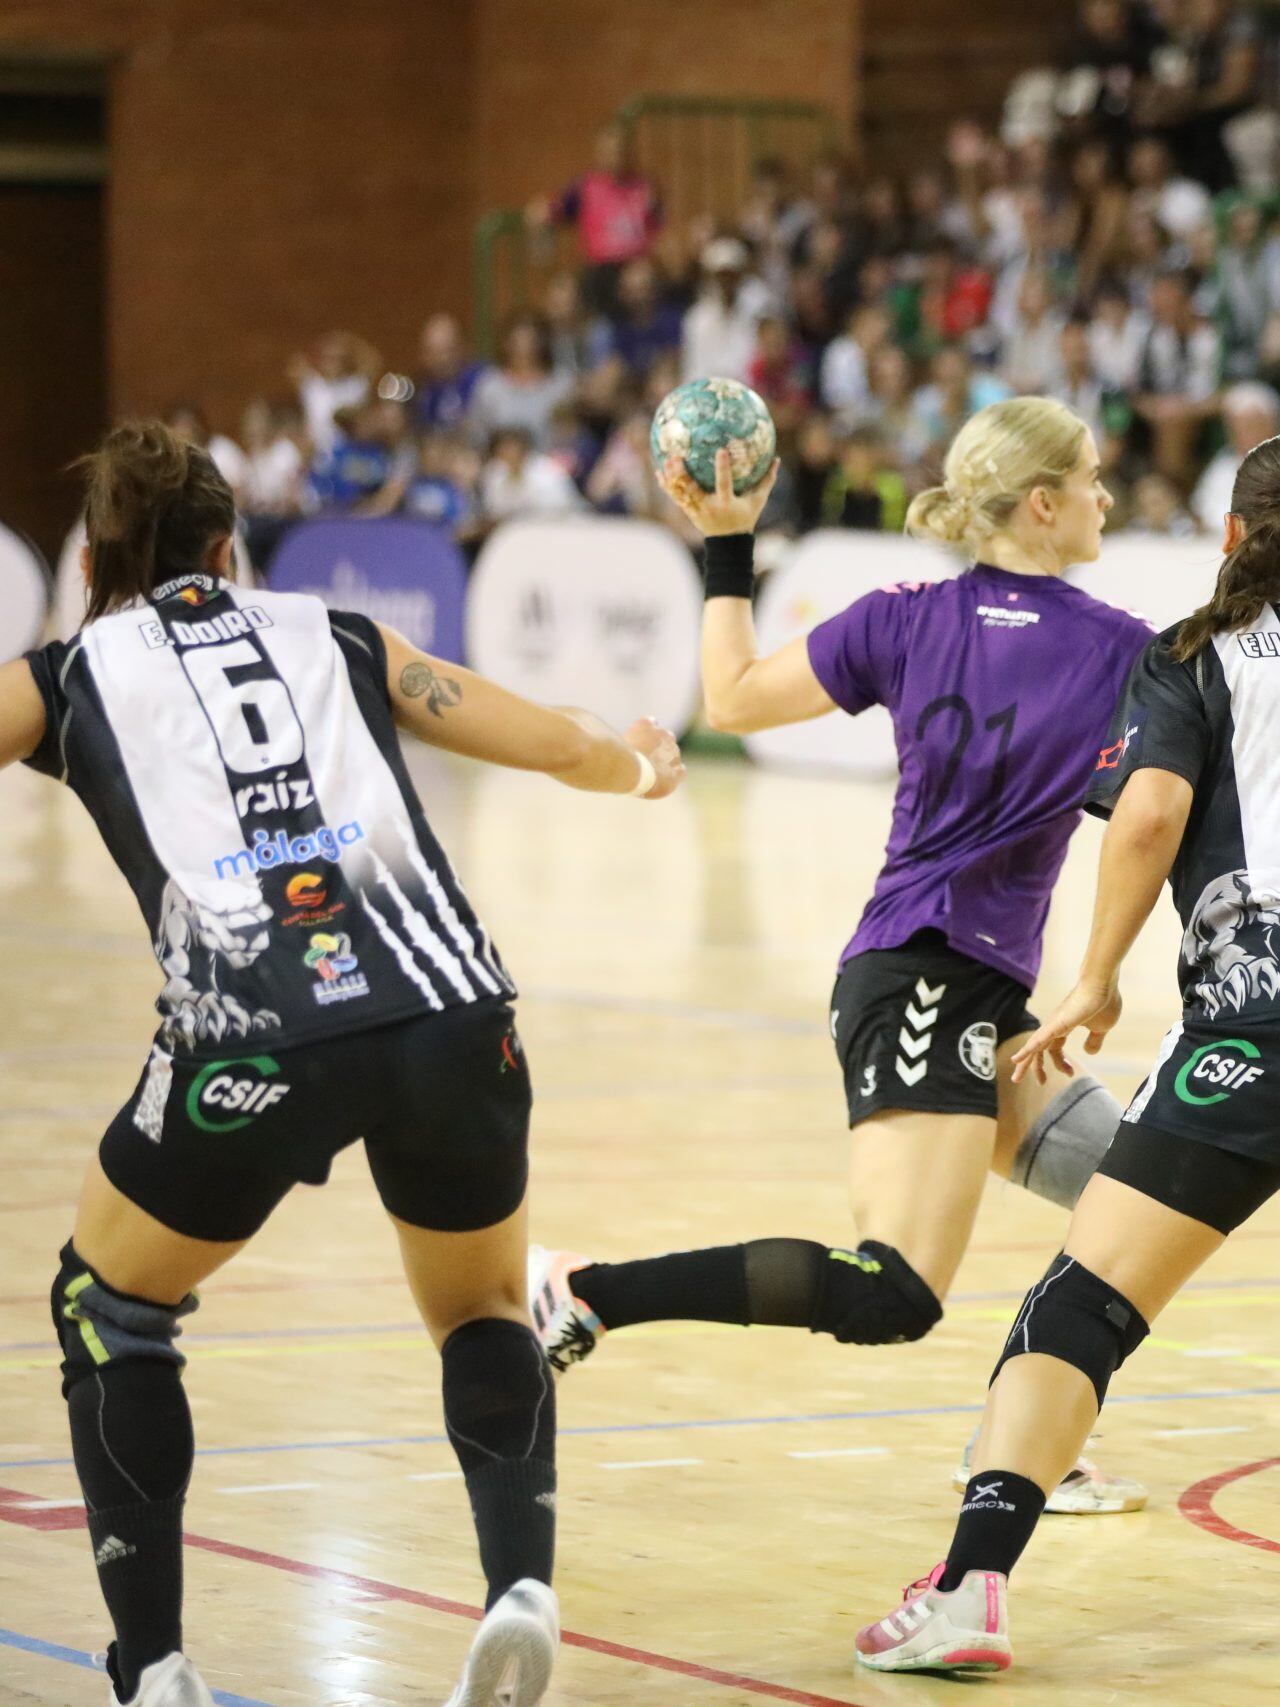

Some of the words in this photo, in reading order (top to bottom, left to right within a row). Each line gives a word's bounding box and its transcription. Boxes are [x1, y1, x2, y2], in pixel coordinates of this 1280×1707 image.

[181, 637, 305, 774] 6
[234, 770, 315, 818] raíz
[213, 821, 365, 881] málaga
[202, 1075, 291, 1114] CSIF
[1193, 1053, 1265, 1091] CSIF
